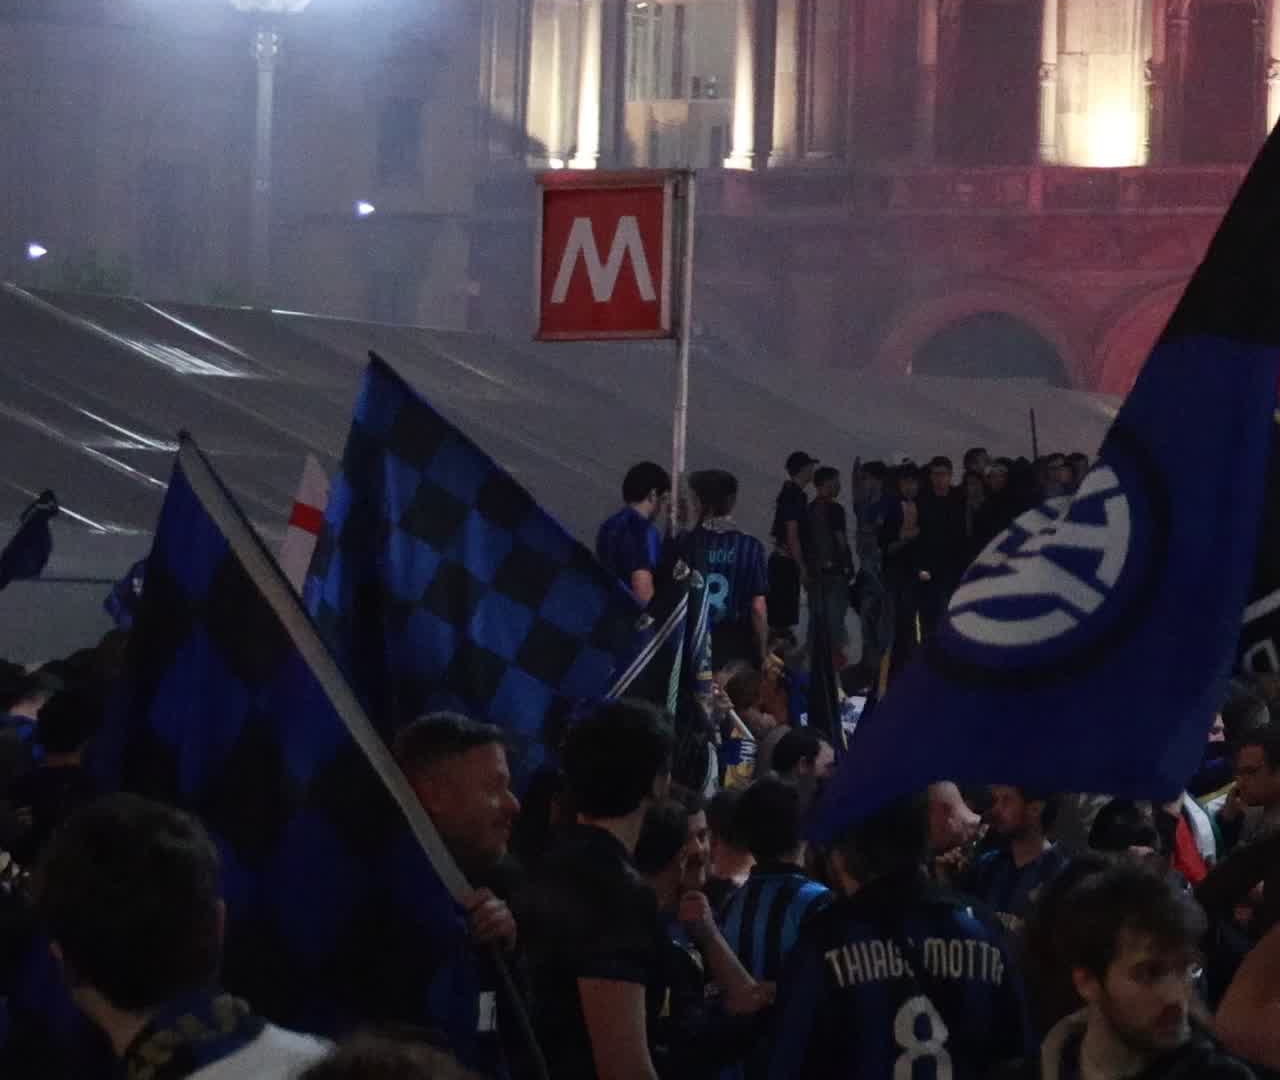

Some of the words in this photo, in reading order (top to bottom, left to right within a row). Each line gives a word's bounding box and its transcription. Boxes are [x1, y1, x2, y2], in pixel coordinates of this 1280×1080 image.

[551, 216, 657, 304] M
[924, 937, 1004, 988] MOTTA
[894, 994, 953, 1080] 8
